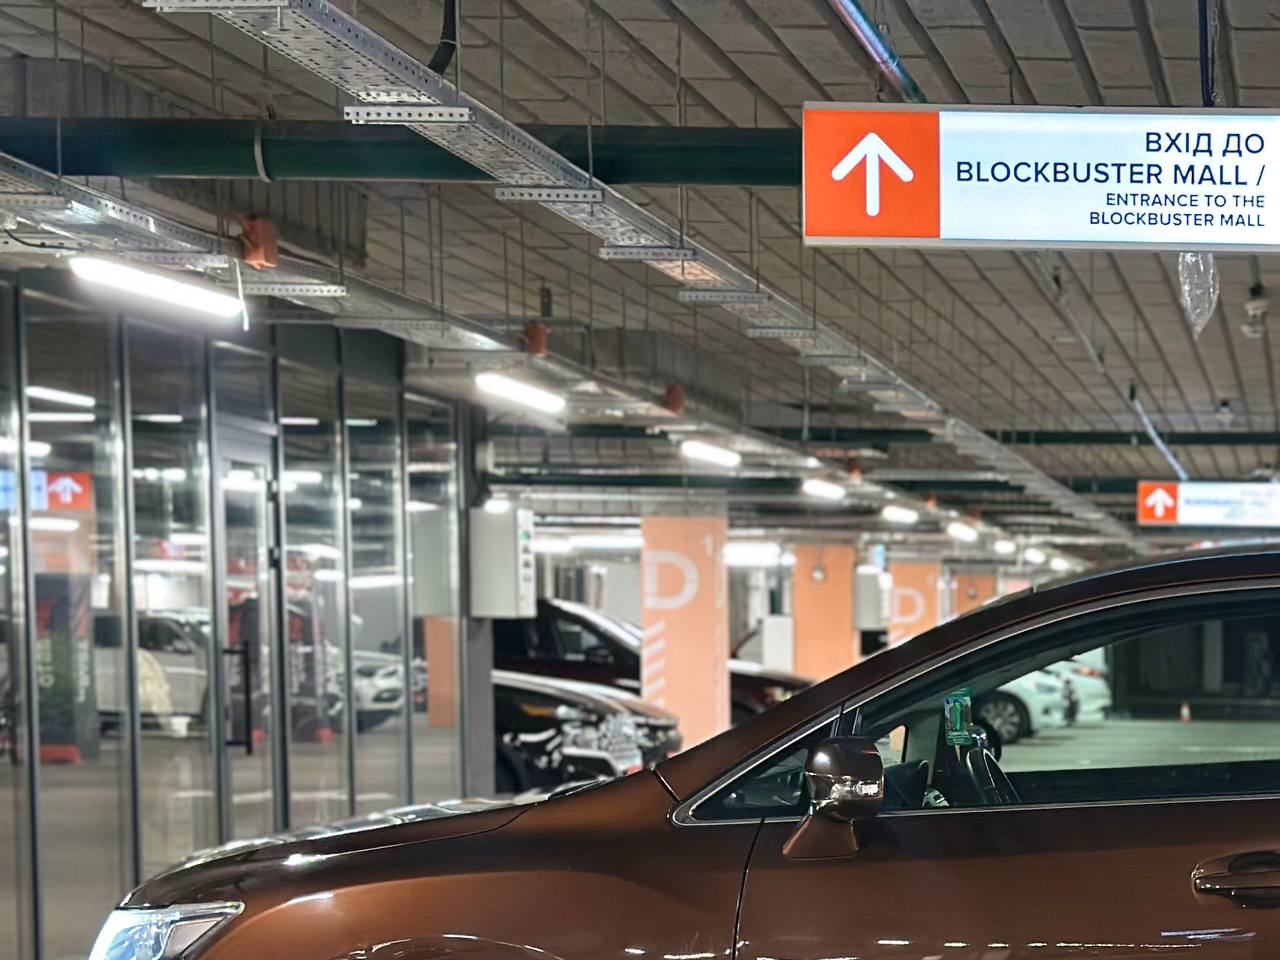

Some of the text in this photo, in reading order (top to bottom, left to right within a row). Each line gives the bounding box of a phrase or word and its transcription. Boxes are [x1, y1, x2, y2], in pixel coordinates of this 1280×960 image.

[1145, 131, 1265, 157] ВХІД ДО
[956, 161, 1163, 184] BLOCKBUSTER
[1173, 163, 1248, 186] MALL
[1106, 192, 1265, 208] ENTRANCE TO THE
[1089, 211, 1265, 227] BLOCKBUSTER MALL
[643, 550, 699, 609] D
